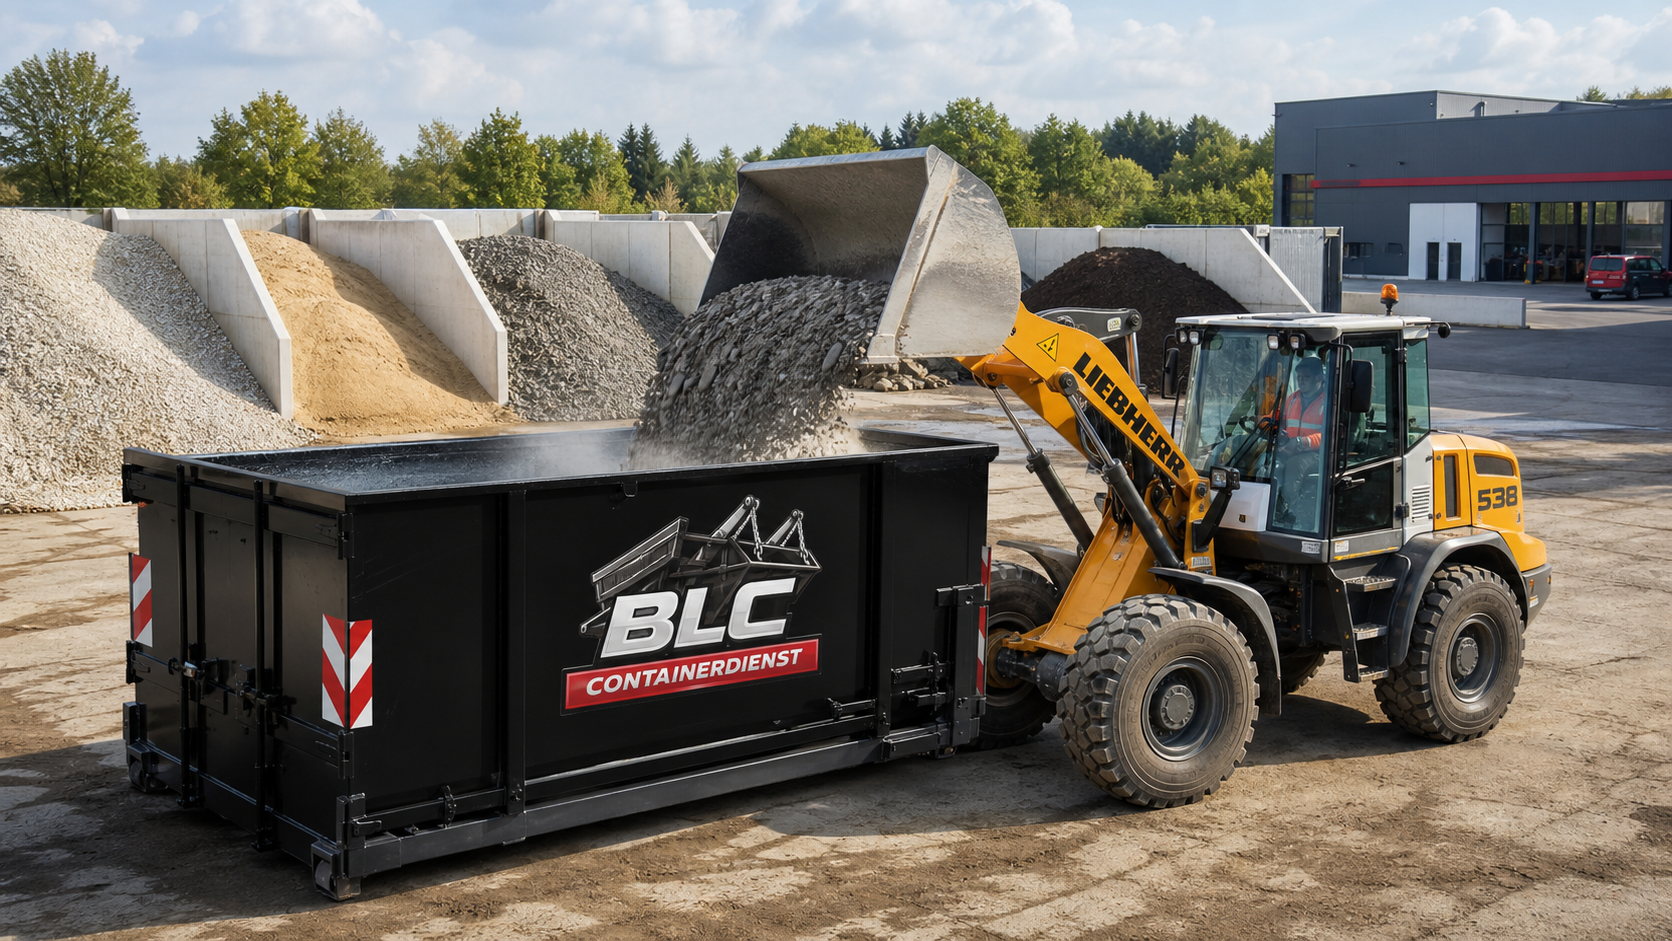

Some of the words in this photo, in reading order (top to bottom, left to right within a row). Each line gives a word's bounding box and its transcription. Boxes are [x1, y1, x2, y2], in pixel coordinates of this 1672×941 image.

[1073, 352, 1185, 479] LIEBHERR
[1478, 485, 1517, 511] 538
[600, 577, 796, 658] BLC
[586, 648, 803, 696] CONTAINERDIENST
